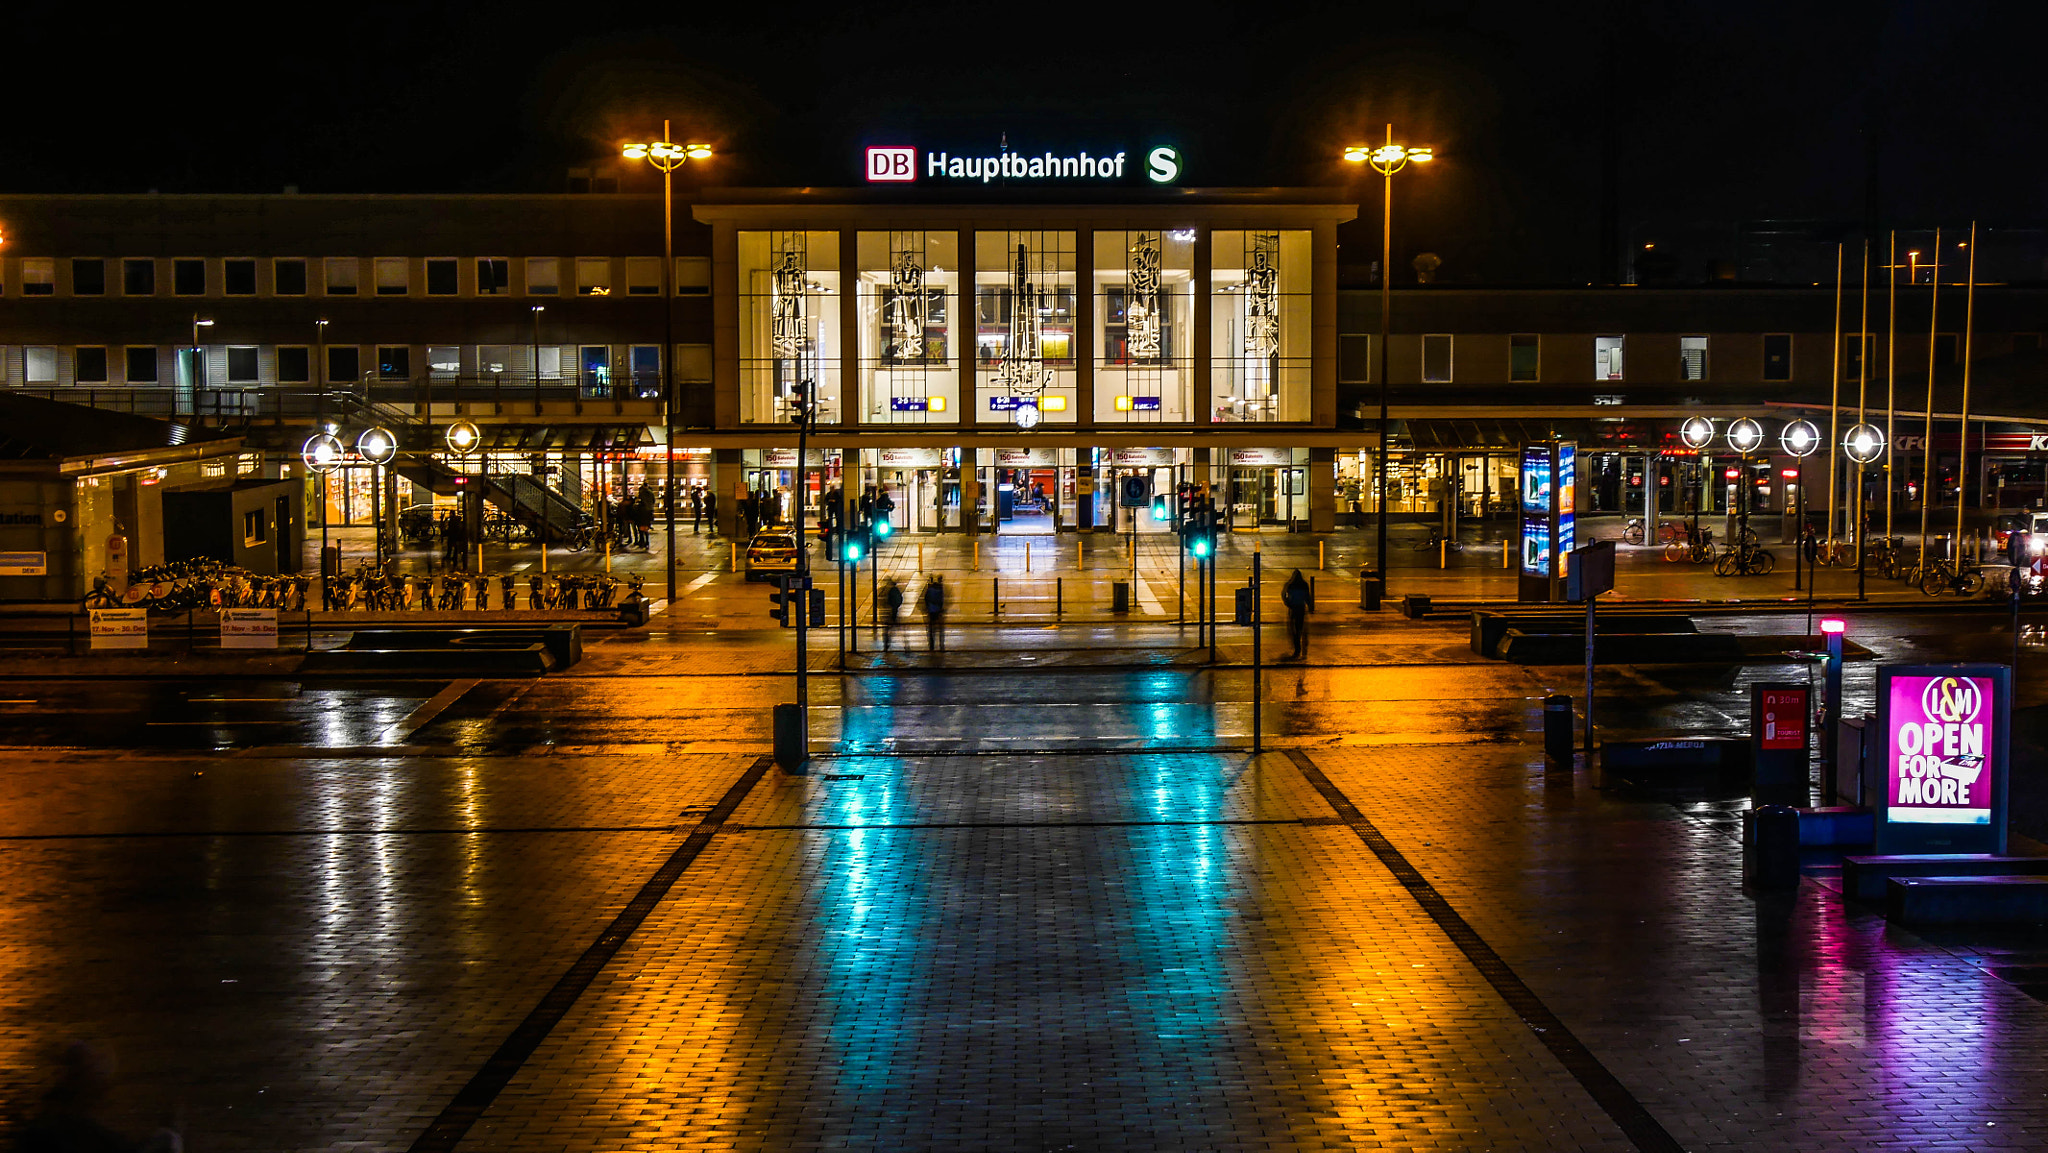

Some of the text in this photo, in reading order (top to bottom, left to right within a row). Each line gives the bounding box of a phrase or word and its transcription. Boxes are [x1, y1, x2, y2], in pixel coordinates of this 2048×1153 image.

[872, 153, 910, 175] DB
[928, 152, 1126, 182] Hauptbahnhof
[1149, 147, 1178, 183] S
[2029, 435, 2048, 450] K
[1932, 677, 1972, 722] L&M
[1898, 722, 1984, 756] OPEN
[1898, 755, 1942, 778] FOR
[1898, 778, 1970, 805] MORE
